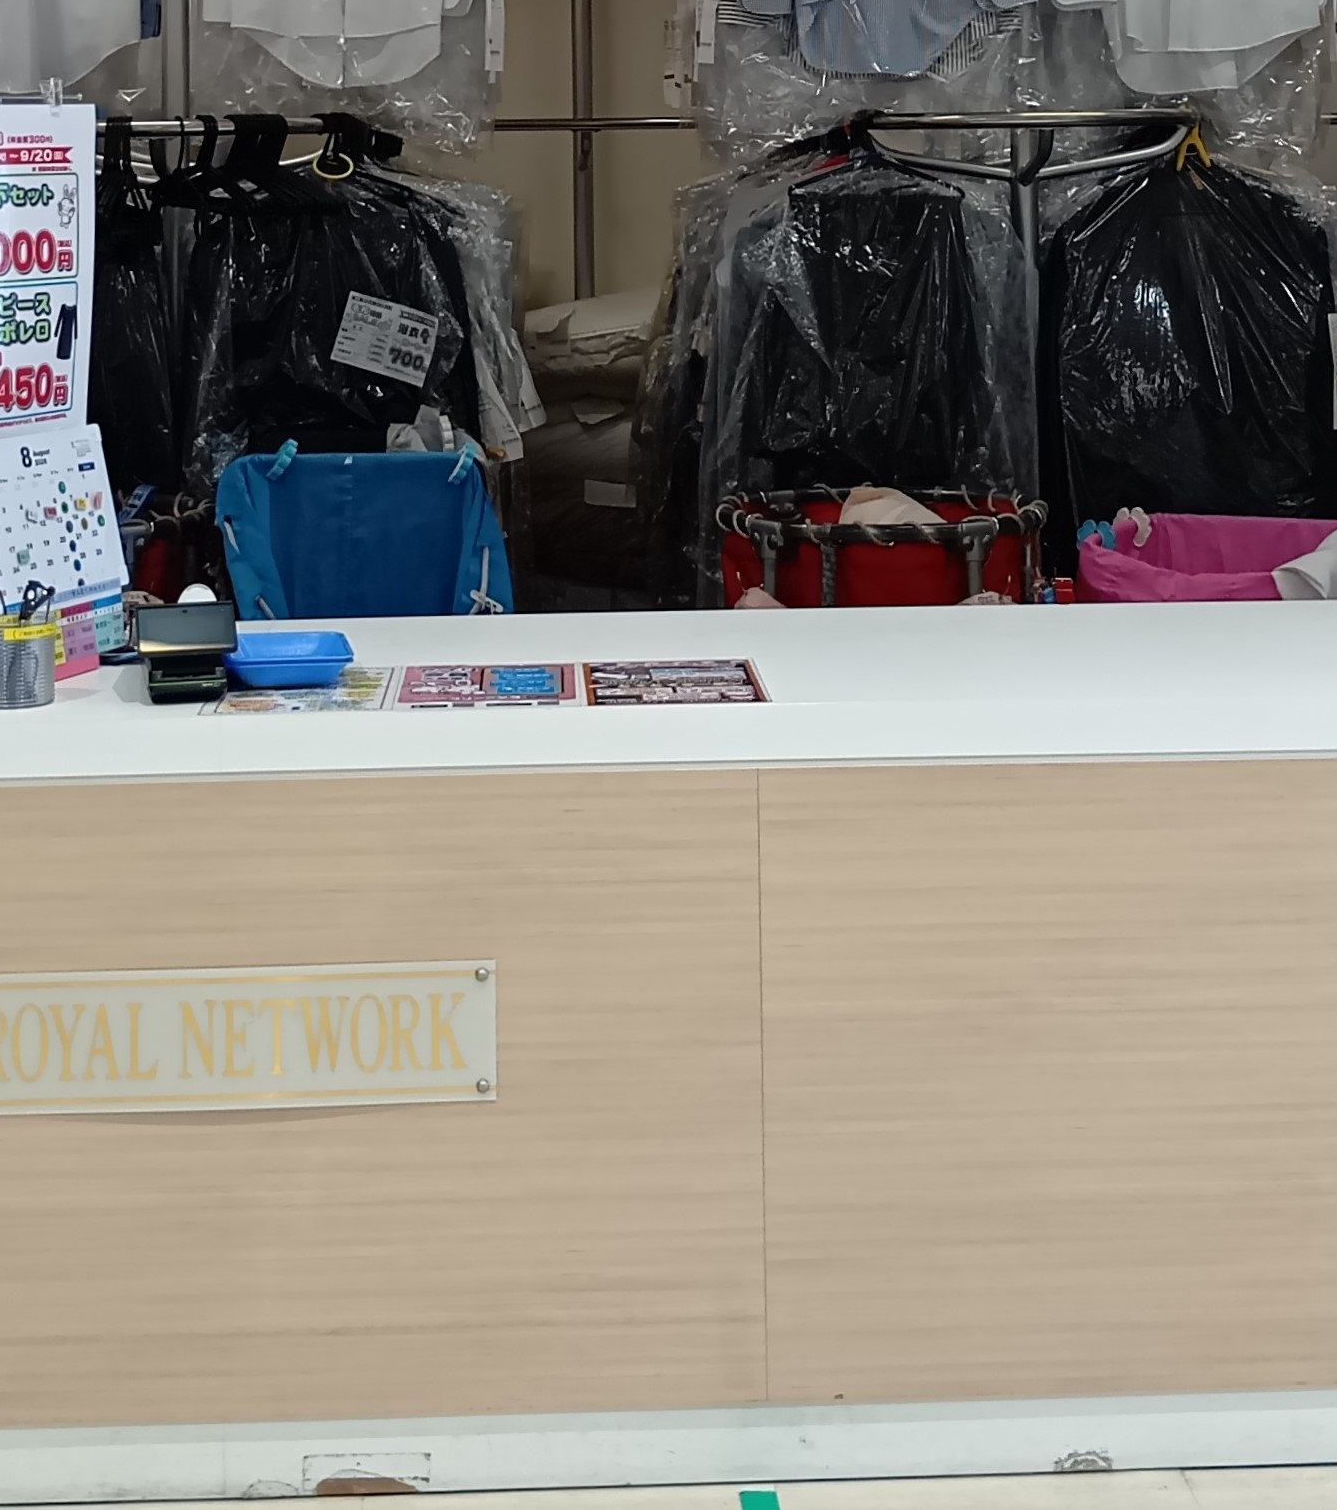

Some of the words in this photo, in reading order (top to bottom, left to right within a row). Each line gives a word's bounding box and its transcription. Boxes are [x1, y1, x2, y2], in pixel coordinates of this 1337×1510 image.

[57, 249, 73, 270] 円
[388, 346, 425, 370] 700
[54, 383, 68, 405] 円
[20, 446, 33, 468] 8
[33, 449, 51, 458] August
[178, 992, 468, 1080] NETWORK
